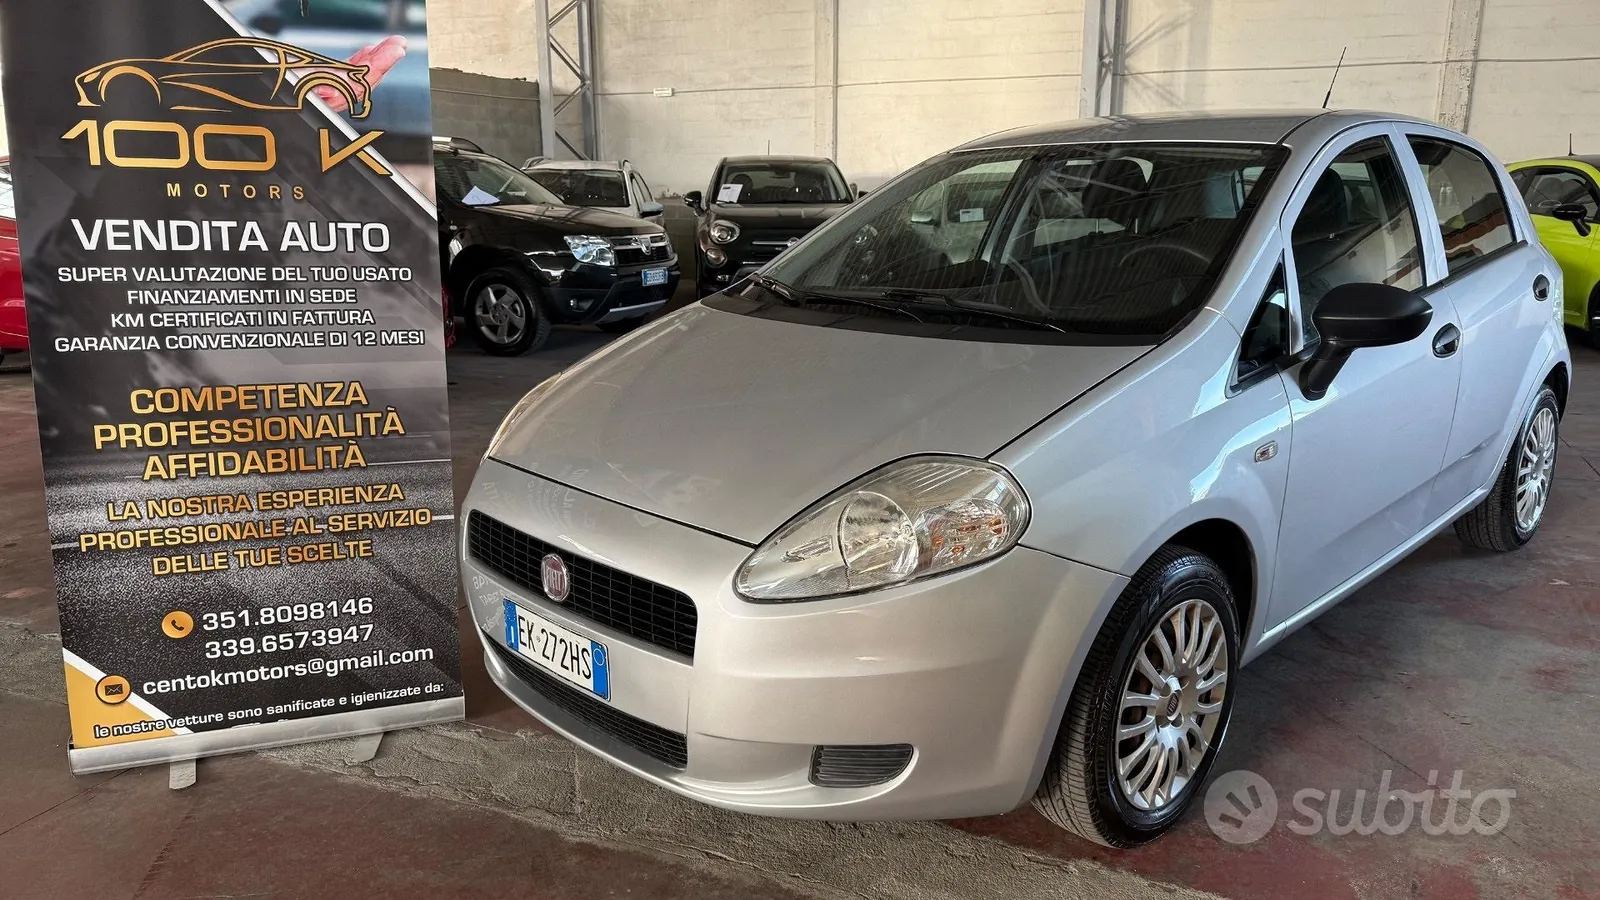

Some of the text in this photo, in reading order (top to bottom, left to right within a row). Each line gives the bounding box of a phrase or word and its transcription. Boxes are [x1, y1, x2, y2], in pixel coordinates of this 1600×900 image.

[61, 119, 393, 176] 100 K
[166, 183, 305, 200] MOTORS
[71, 218, 391, 252] VENDITA AUTO
[57, 266, 413, 283] SUPER VALUTAZIONE DEL TUO USATO
[127, 289, 357, 306] FINANZIAMENTI IN SEDE
[111, 310, 375, 328] KM CERTIFICATI IN FATTURA
[54, 330, 425, 353] GARANZIA CONVENZIONALE DI 12 MESI
[129, 381, 368, 415] COMPETENZA
[93, 405, 405, 450] PROFESSIONALITÀ
[142, 440, 368, 481] AFFIDABILITÀ
[107, 483, 404, 522] LA NOSTRA ESPERIENZA
[79, 507, 432, 553] PROFESSIONALE AL SERVIZIO
[152, 539, 374, 576] DELLE TUE SCELTE
[202, 597, 374, 632] 351.8098146
[205, 624, 374, 660] 339.6573947
[517, 614, 592, 680] EK 272HS
[142, 646, 434, 696] centokmotors@gmail.com
[94, 723, 110, 739] le
[112, 717, 164, 737] nostre
[168, 710, 224, 729] vetture
[228, 705, 263, 720] sono
[266, 695, 336, 716] sanificate
[339, 696, 348, 706] e
[350, 686, 421, 707] igienizzate
[424, 682, 445, 696] da:
